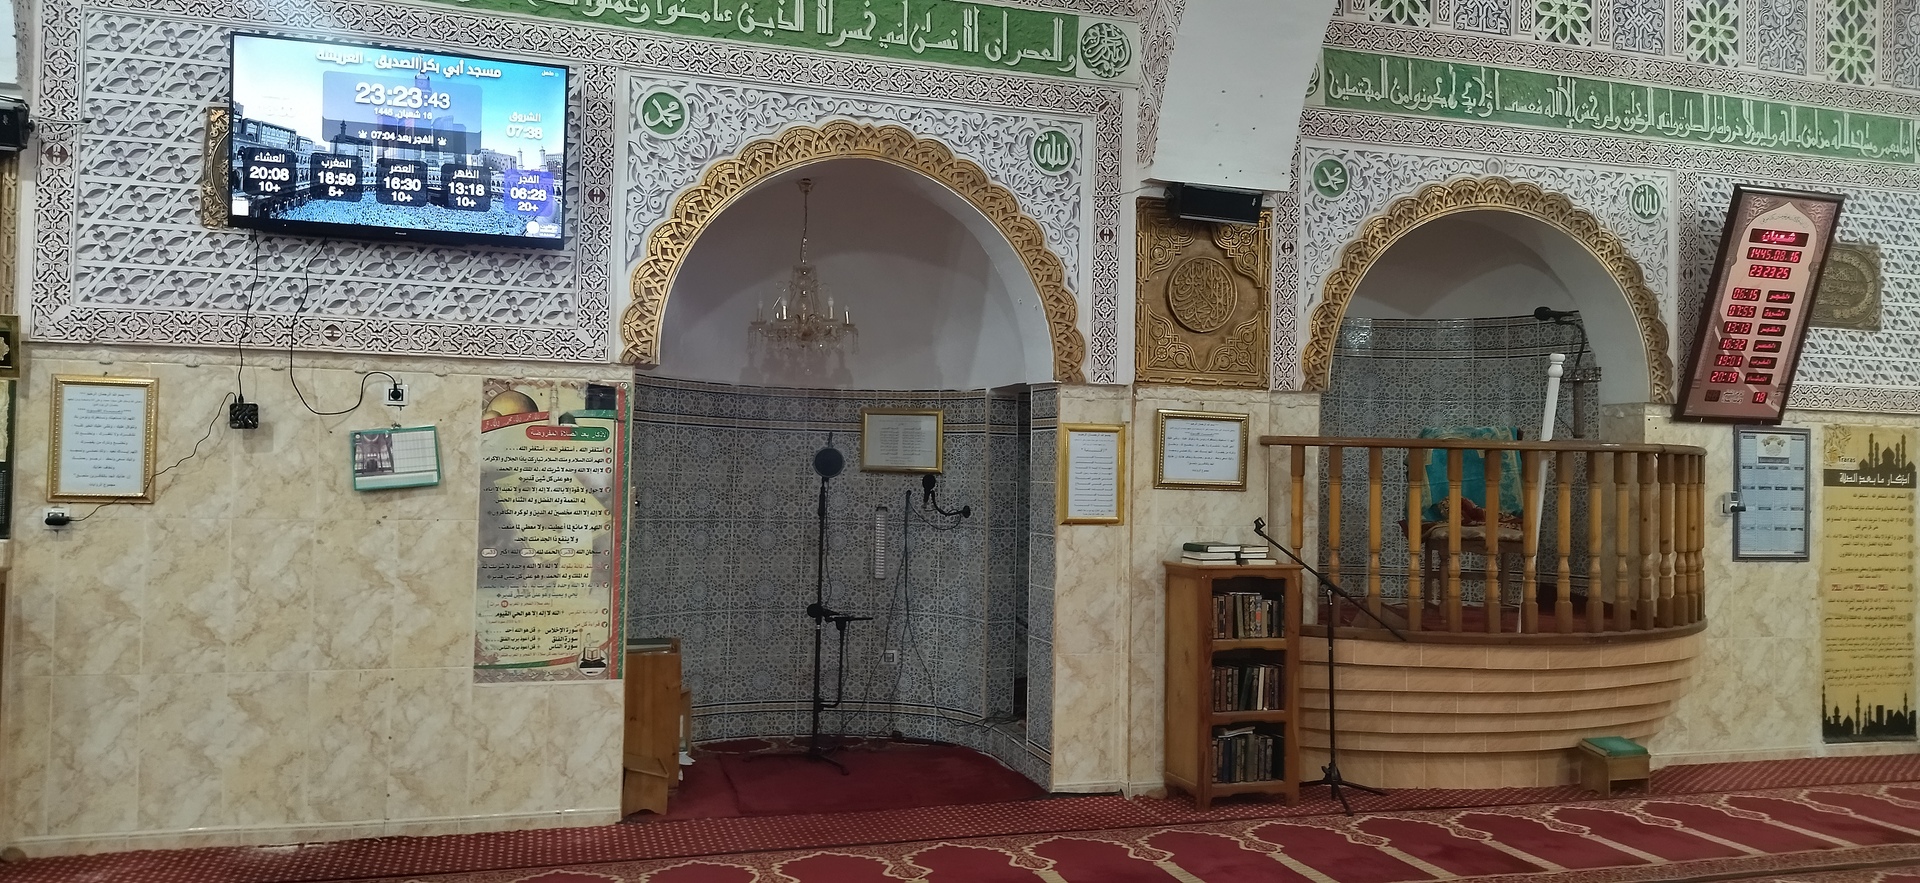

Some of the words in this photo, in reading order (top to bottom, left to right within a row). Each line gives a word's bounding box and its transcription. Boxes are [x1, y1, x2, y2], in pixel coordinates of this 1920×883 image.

[374, 54, 420, 70] الصديق
[442, 60, 464, 78] أبي
[466, 65, 502, 79] مسجد
[354, 82, 450, 109] 23:23:43
[371, 130, 395, 140] 07:04
[254, 152, 285, 163] العشاء
[321, 159, 351, 169] المغرب
[389, 164, 414, 174] العصر
[250, 166, 290, 181] 20:08
[453, 169, 479, 180] الظهر
[518, 175, 539, 185] الفجر
[448, 182, 485, 197] 13:18
